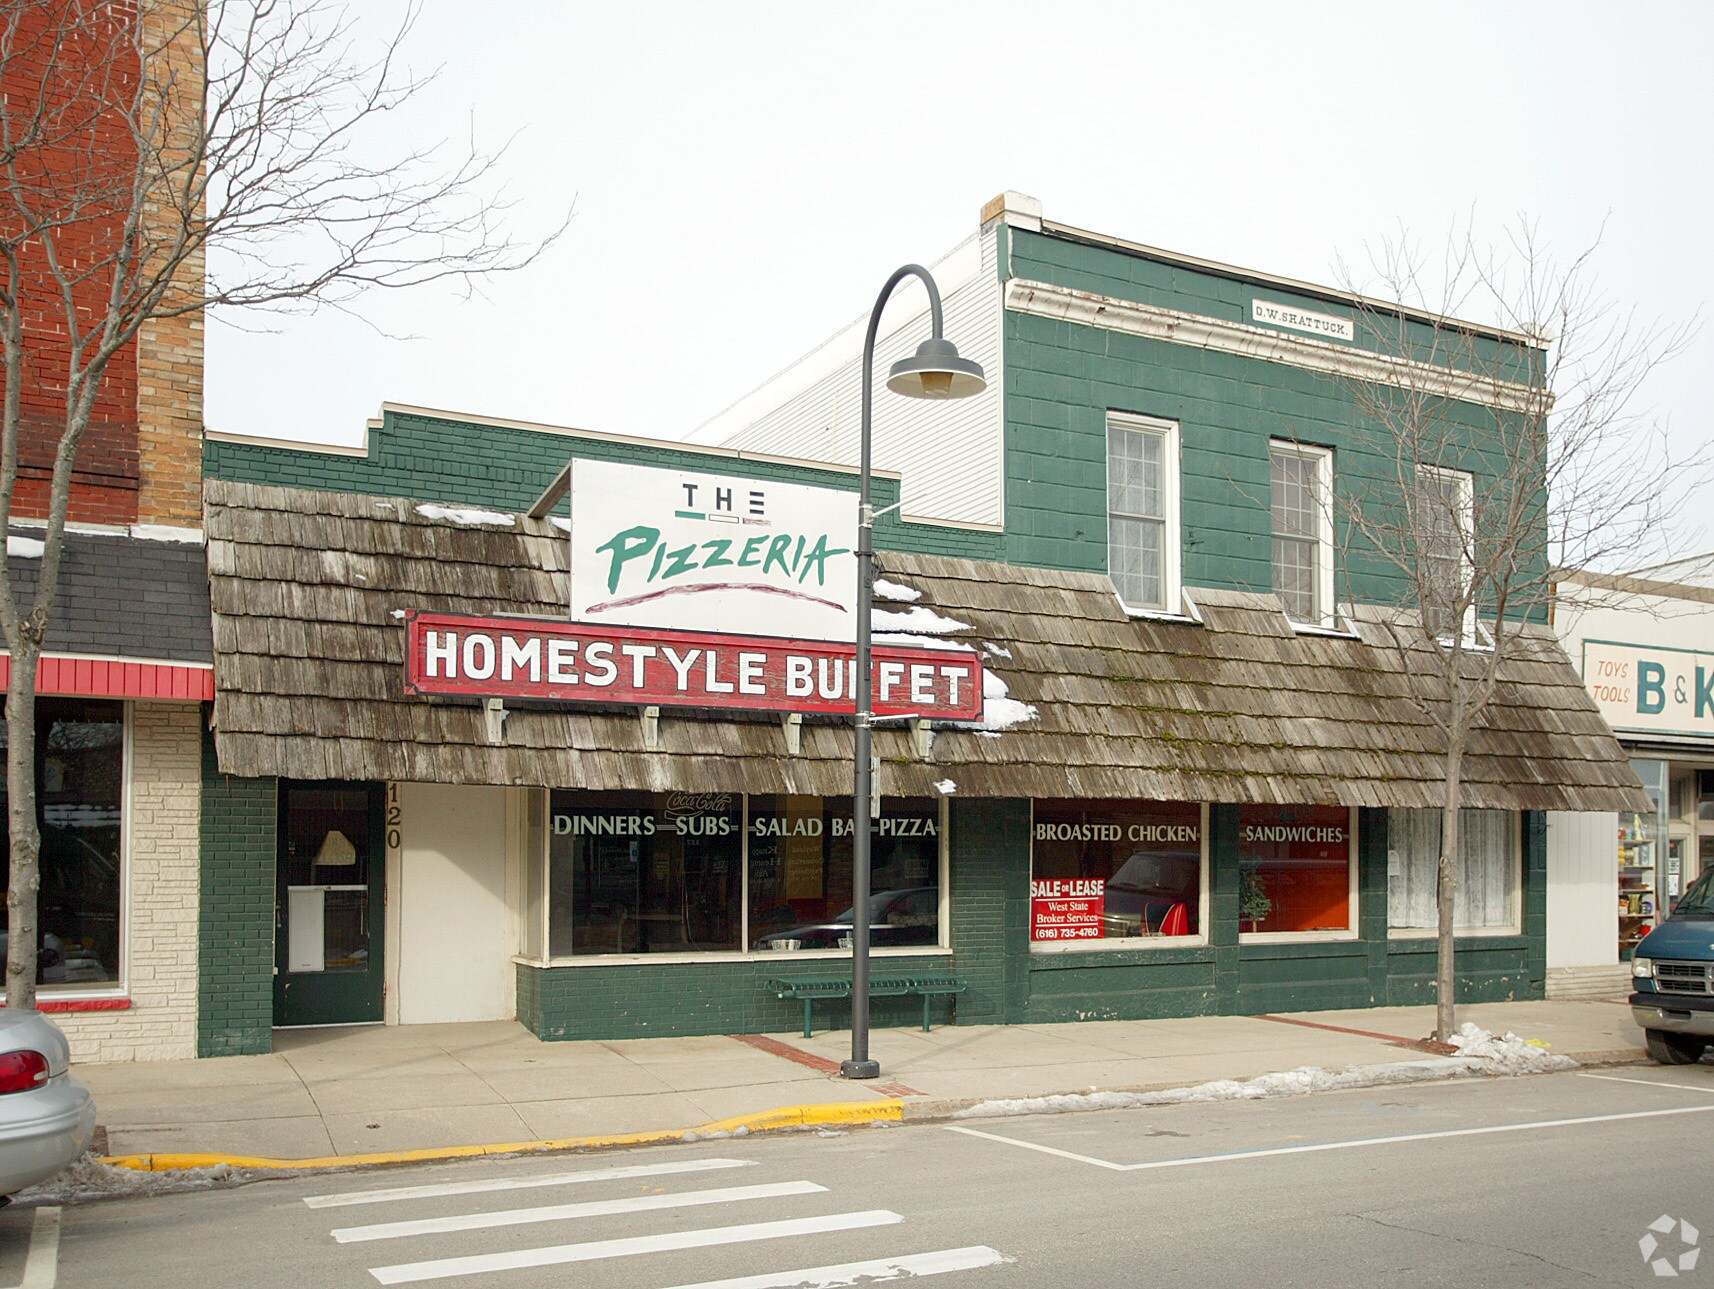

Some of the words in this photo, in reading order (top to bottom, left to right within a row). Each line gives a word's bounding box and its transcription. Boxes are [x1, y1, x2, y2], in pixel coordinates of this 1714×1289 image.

[682, 482, 765, 515] THE
[596, 526, 850, 595] PIZZERIA
[425, 629, 768, 696] HOMESTYLE
[1597, 660, 1629, 678] TOYS
[1593, 685, 1630, 703] TOOLS
[1636, 661, 1666, 714] B
[1674, 675, 1688, 704] &
[387, 783, 401, 849] 120
[553, 814, 656, 836] DINNERS
[675, 816, 730, 837] SUBS
[754, 817, 823, 838] SALAD
[831, 818, 855, 837] BA
[879, 818, 937, 837] PIZZA
[1036, 823, 1122, 842] BROASTED
[1128, 825, 1197, 843] CHICKEN
[1246, 826, 1343, 843] SANDWICHES
[1031, 881, 1061, 897] SALE
[1070, 880, 1104, 896] LEASE
[1048, 902, 1068, 911] West
[1070, 902, 1088, 911] State
[1036, 913, 1065, 923] Broker
[1067, 913, 1098, 922] Services
[1036, 928, 1058, 938] (616)
[1060, 927, 1098, 937] 735-4760
